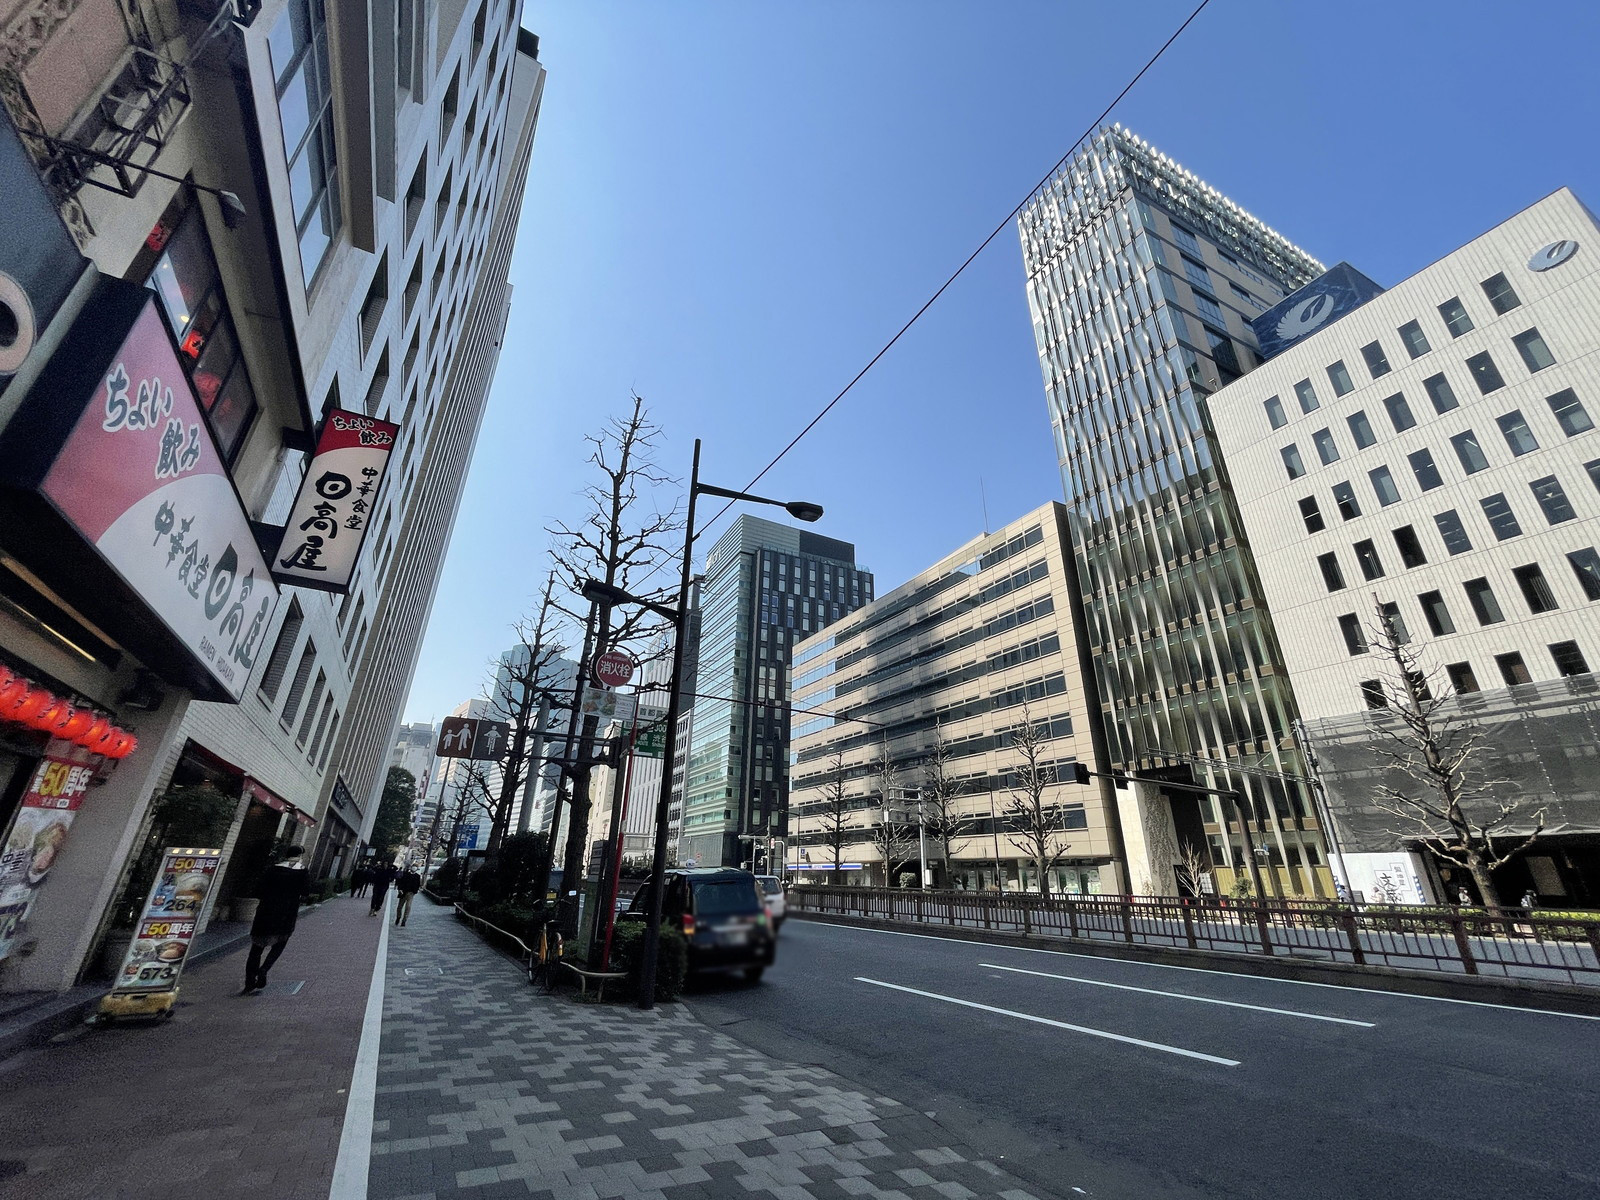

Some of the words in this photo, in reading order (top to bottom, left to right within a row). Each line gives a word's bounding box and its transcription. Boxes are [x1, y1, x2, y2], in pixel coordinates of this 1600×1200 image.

[103, 363, 173, 432] ちょい
[332, 416, 374, 431] ちょい
[155, 418, 201, 480] 飲み
[359, 430, 392, 445] 飲み
[279, 470, 352, 572] 日高屋
[344, 466, 379, 531] 中華食堂
[600, 659, 631, 678] 消火栓
